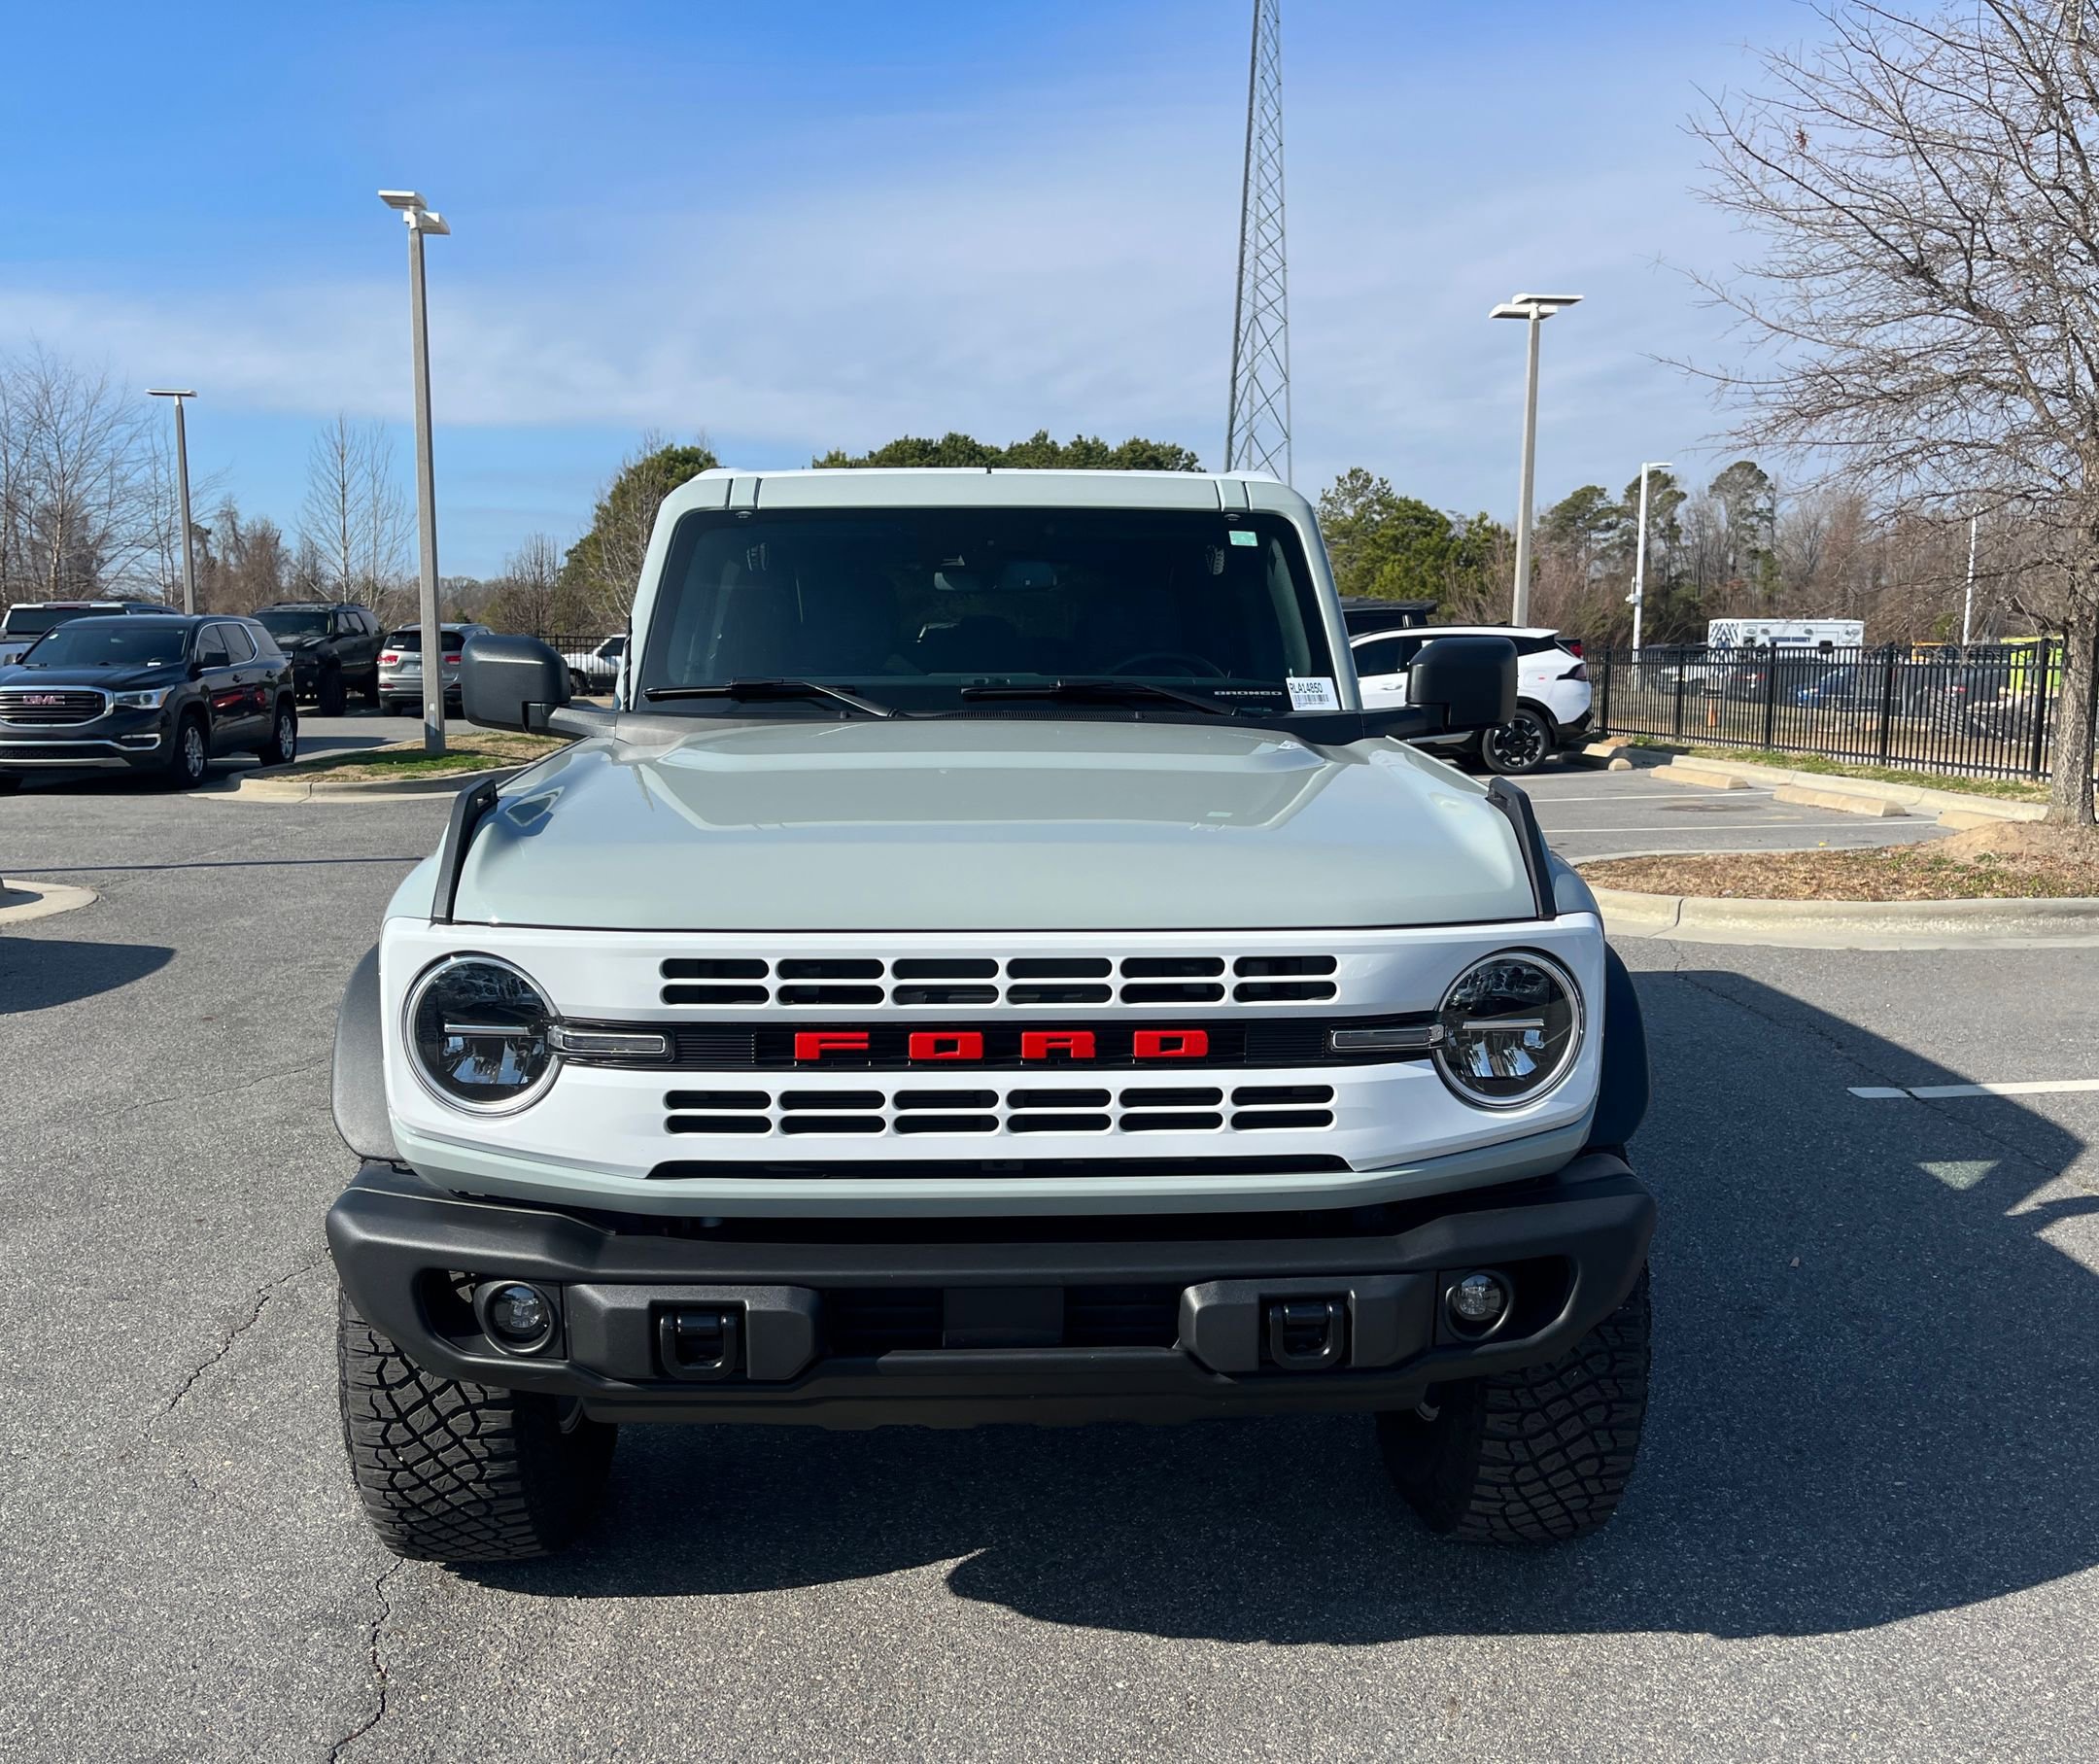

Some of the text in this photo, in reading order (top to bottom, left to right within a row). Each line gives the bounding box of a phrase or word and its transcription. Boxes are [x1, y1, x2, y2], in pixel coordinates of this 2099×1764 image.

[1289, 682, 1323, 694] RLA14850
[22, 695, 65, 705] GMC
[794, 1030, 1209, 1060] FORD
